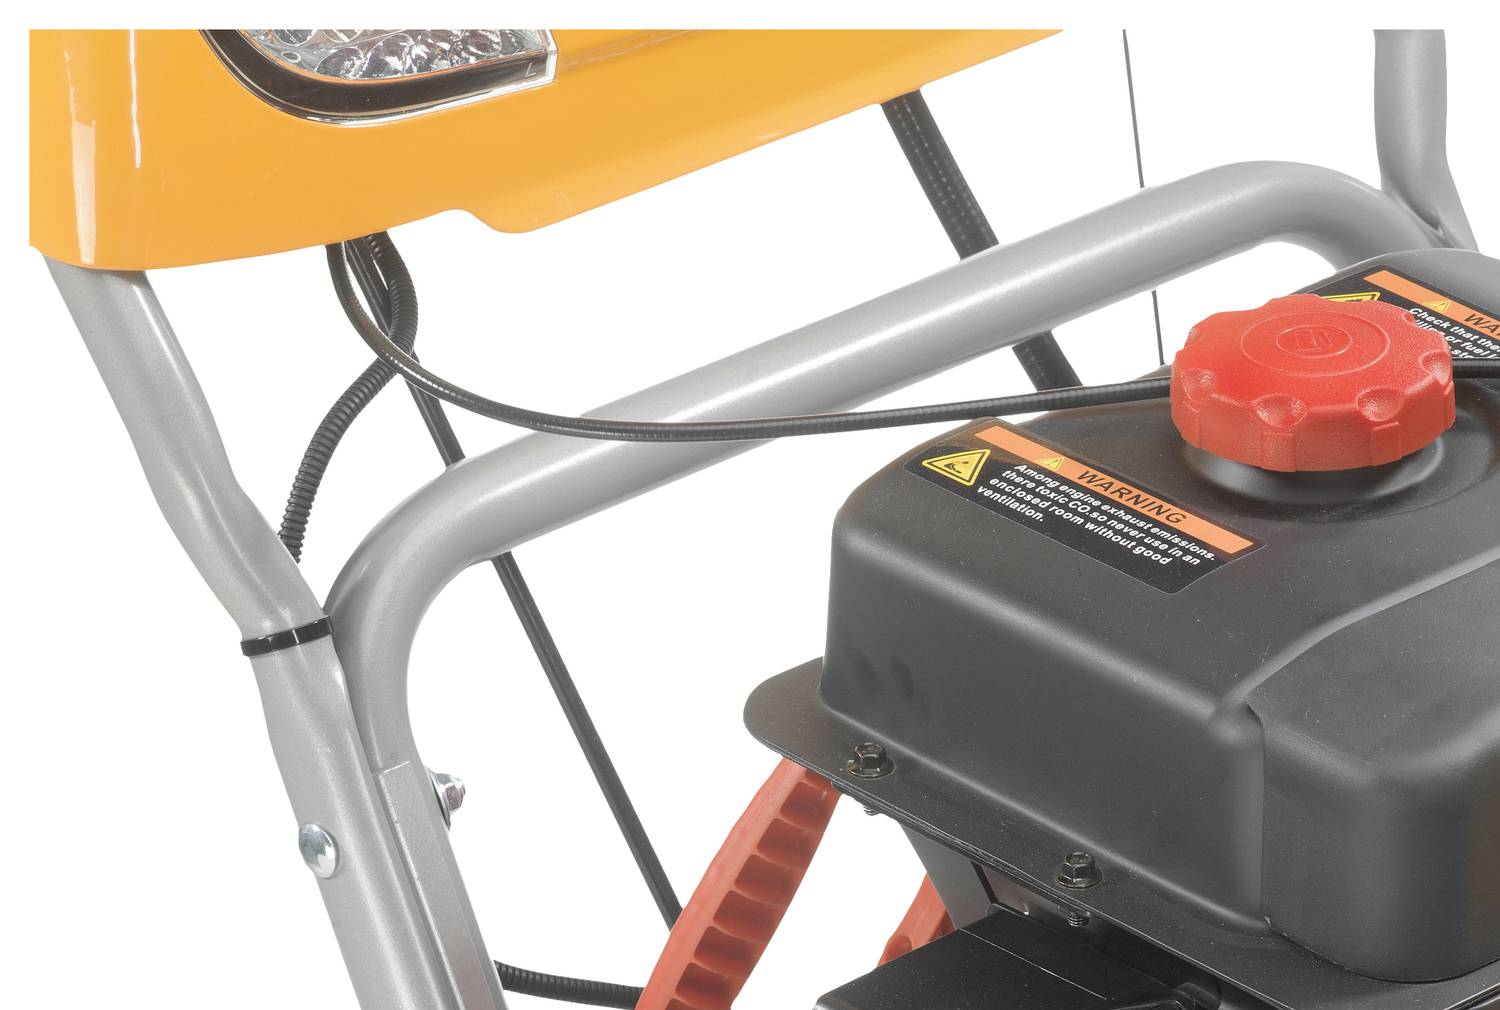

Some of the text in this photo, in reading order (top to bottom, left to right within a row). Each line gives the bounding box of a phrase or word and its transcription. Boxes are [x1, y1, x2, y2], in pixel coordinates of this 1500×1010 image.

[1409, 308, 1451, 328] Check
[1450, 326, 1479, 341] that
[1445, 335, 1462, 345] or
[1461, 342, 1491, 357] fuel
[977, 485, 1044, 522] ventilation.
[989, 478, 1173, 565] enclosed room without good
[1001, 470, 1036, 489] there
[1035, 485, 1069, 504] toxic
[1107, 519, 1146, 539] never
[1144, 536, 1169, 551] use
[1168, 546, 1183, 557] in
[1182, 554, 1201, 565] an
[1014, 464, 1215, 560] Among engine exhaust emissions.
[1077, 470, 1187, 524] WARNING
